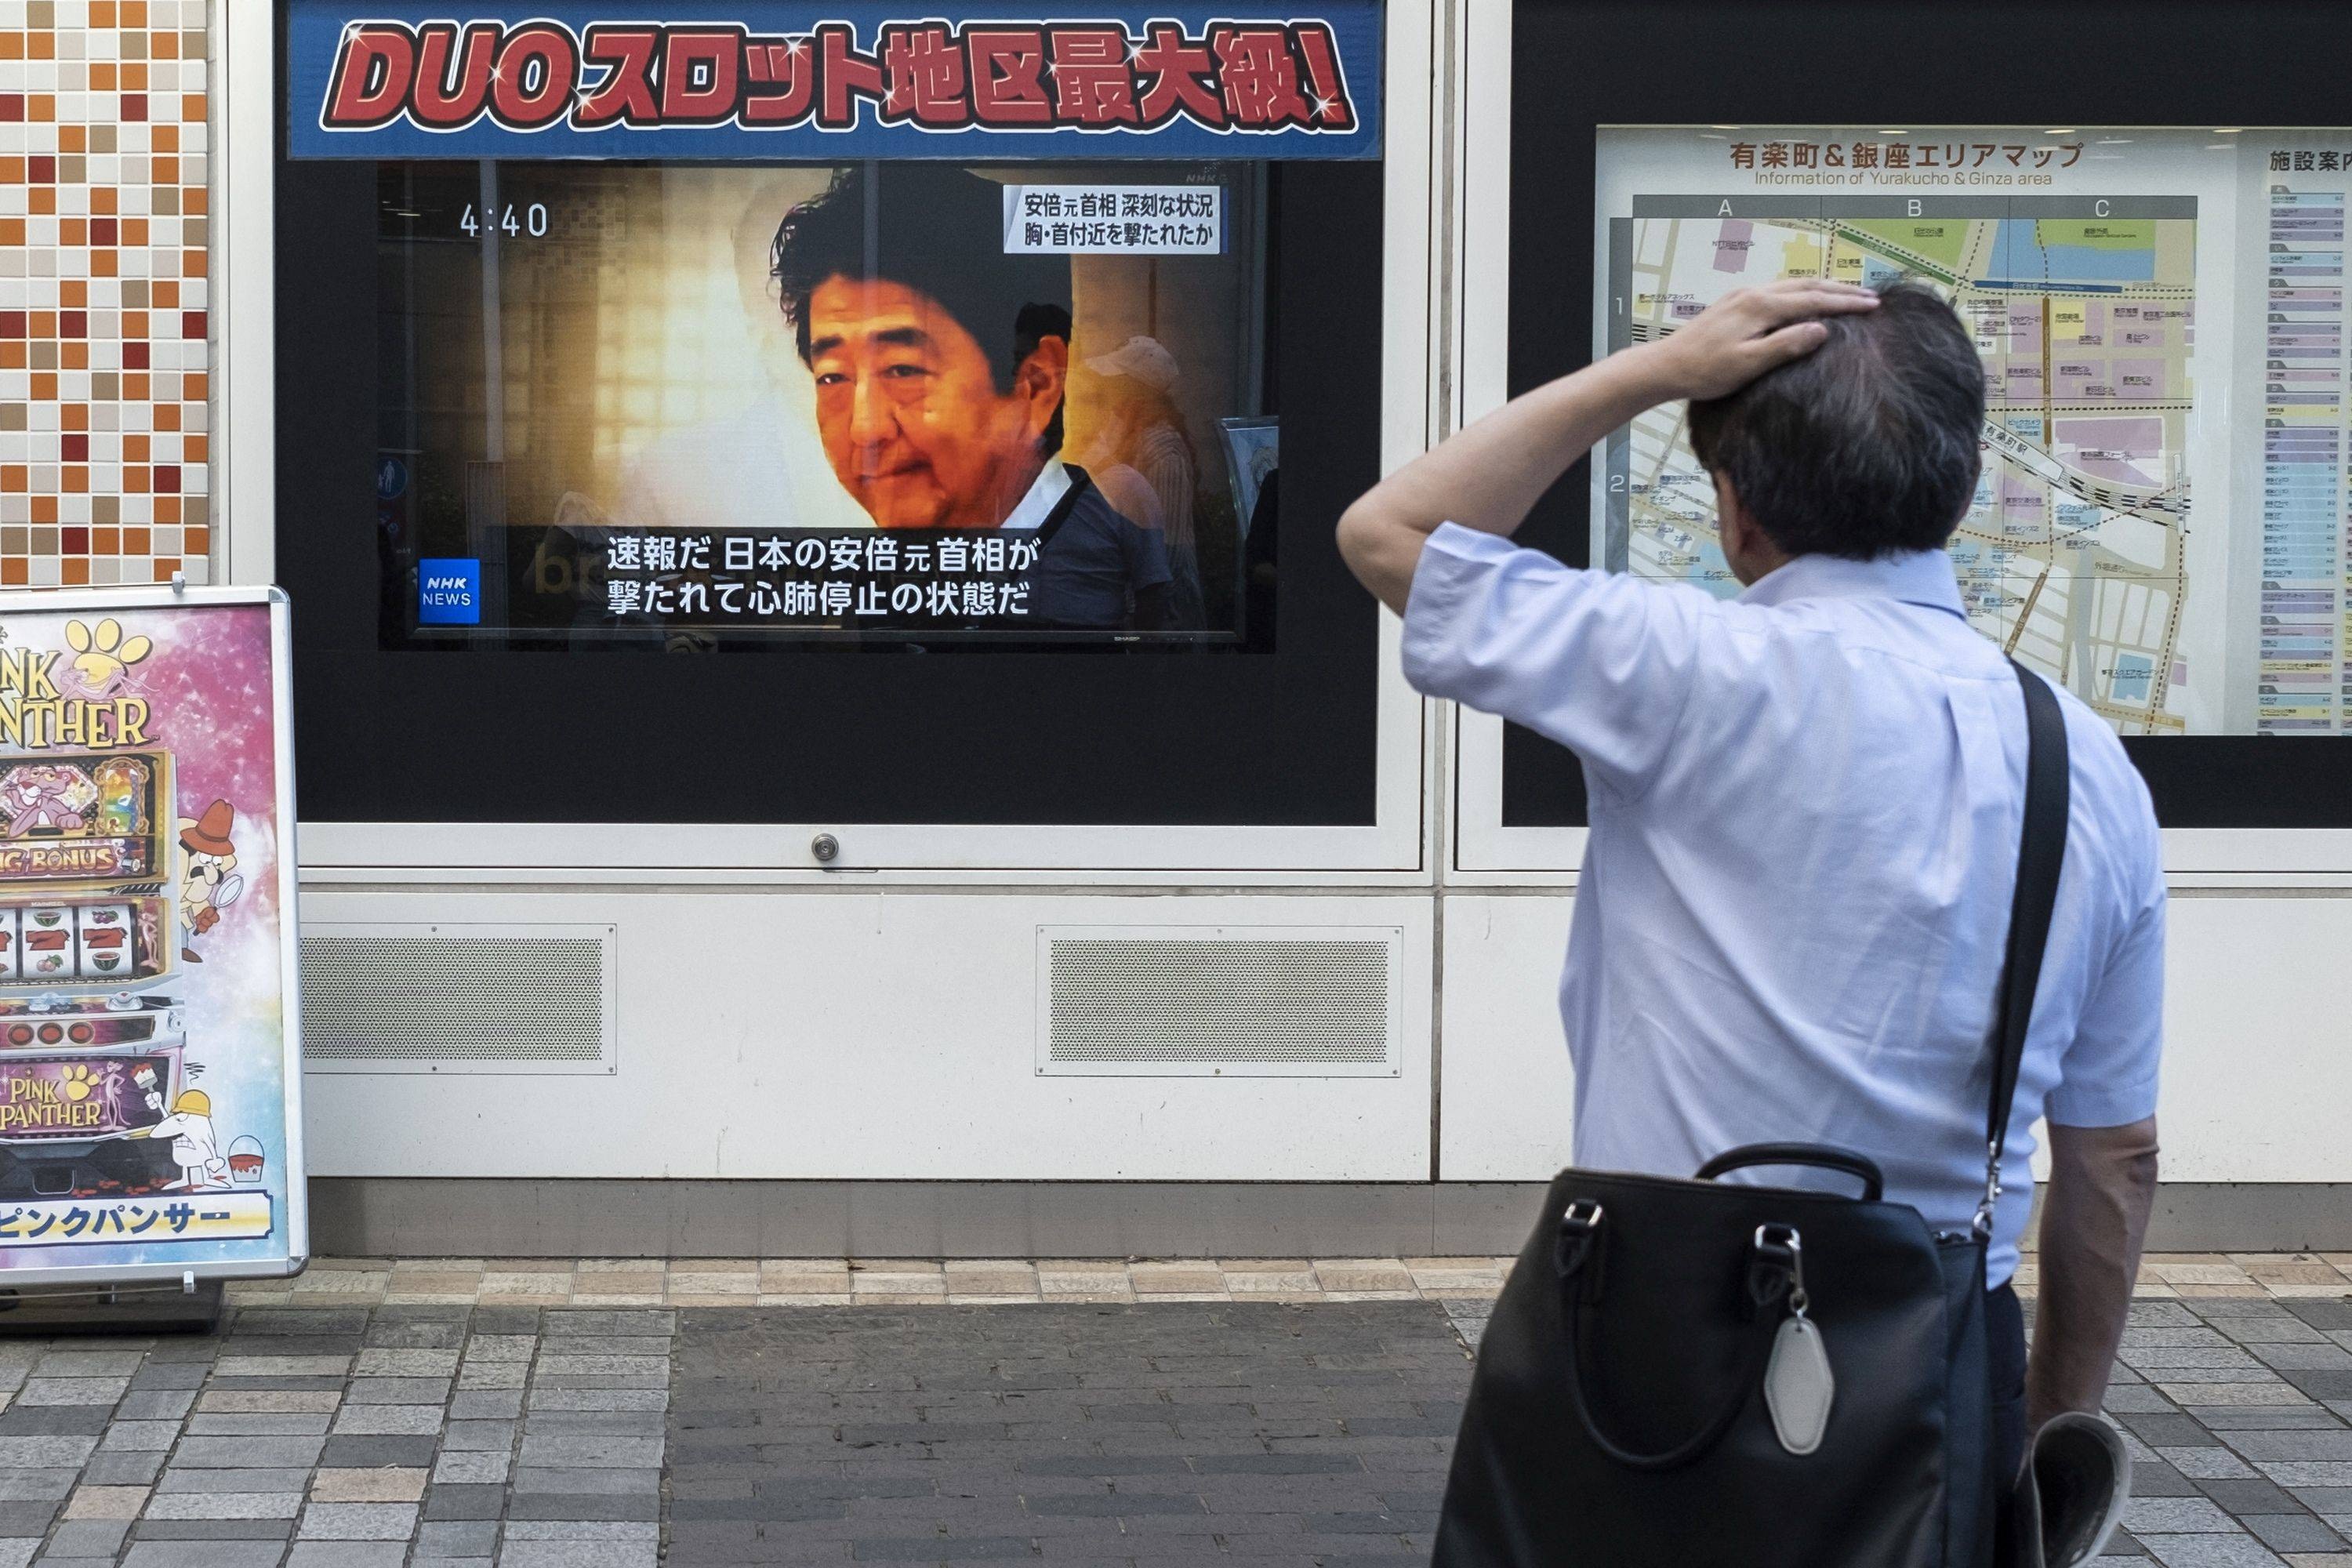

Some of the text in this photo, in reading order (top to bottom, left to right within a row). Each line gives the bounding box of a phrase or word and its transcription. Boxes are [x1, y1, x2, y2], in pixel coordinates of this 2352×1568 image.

[323, 21, 1357, 132] DUOスロット地区最大級!
[1730, 142, 2085, 169] 有楽町&銀座エリアマップ
[1755, 171, 2053, 186] Information of Yurakucho & Ginza area
[1025, 193, 1213, 217] 安倍元首相 深刻な状況
[1718, 199, 1733, 216] A
[1908, 198, 1922, 217] B
[2095, 198, 2110, 217] C
[460, 203, 547, 237] 4:40
[1616, 297, 1622, 315] 1
[1986, 426, 2027, 456] 有楽町駅
[1610, 474, 1624, 492] 2
[608, 536, 711, 572] 速報だ
[724, 536, 1041, 572] 日本の安倍元首相が
[427, 577, 466, 589] NHK
[423, 593, 472, 606] NEWS
[608, 580, 1029, 616] 撃たれて心肺停止の状態だ
[0, 647, 62, 701] NK
[0, 698, 150, 749] NTHER
[0, 848, 115, 873] IG BONUS
[9, 1077, 60, 1104] PINK
[0, 1102, 101, 1131] PANTHER
[0, 1203, 230, 1238] ピンクパンサー
